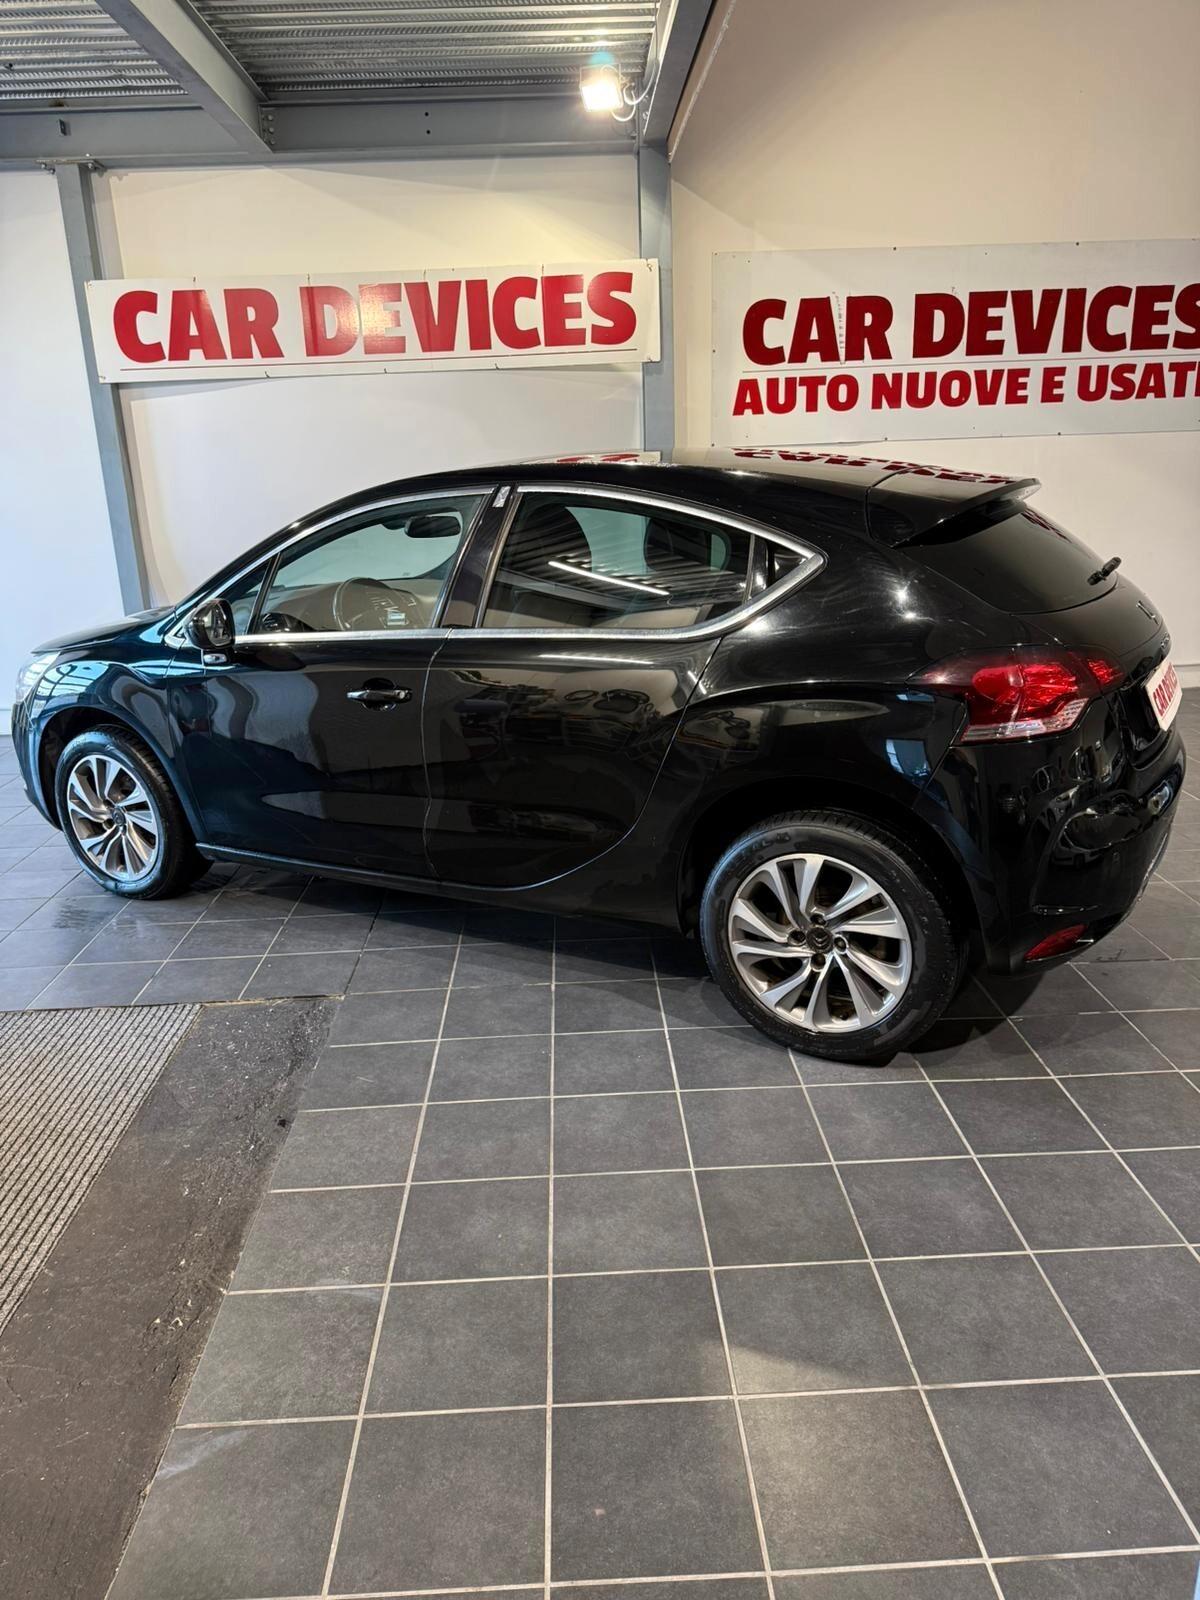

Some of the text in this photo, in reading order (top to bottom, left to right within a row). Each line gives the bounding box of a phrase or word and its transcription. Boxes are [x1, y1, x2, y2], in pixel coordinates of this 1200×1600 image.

[112, 271, 638, 364] CAR DEVICES
[742, 283, 1200, 366] CAR DEVICES
[731, 360, 1200, 417] AUTO NUOVE E USAT
[1153, 684, 1169, 717] CAR
